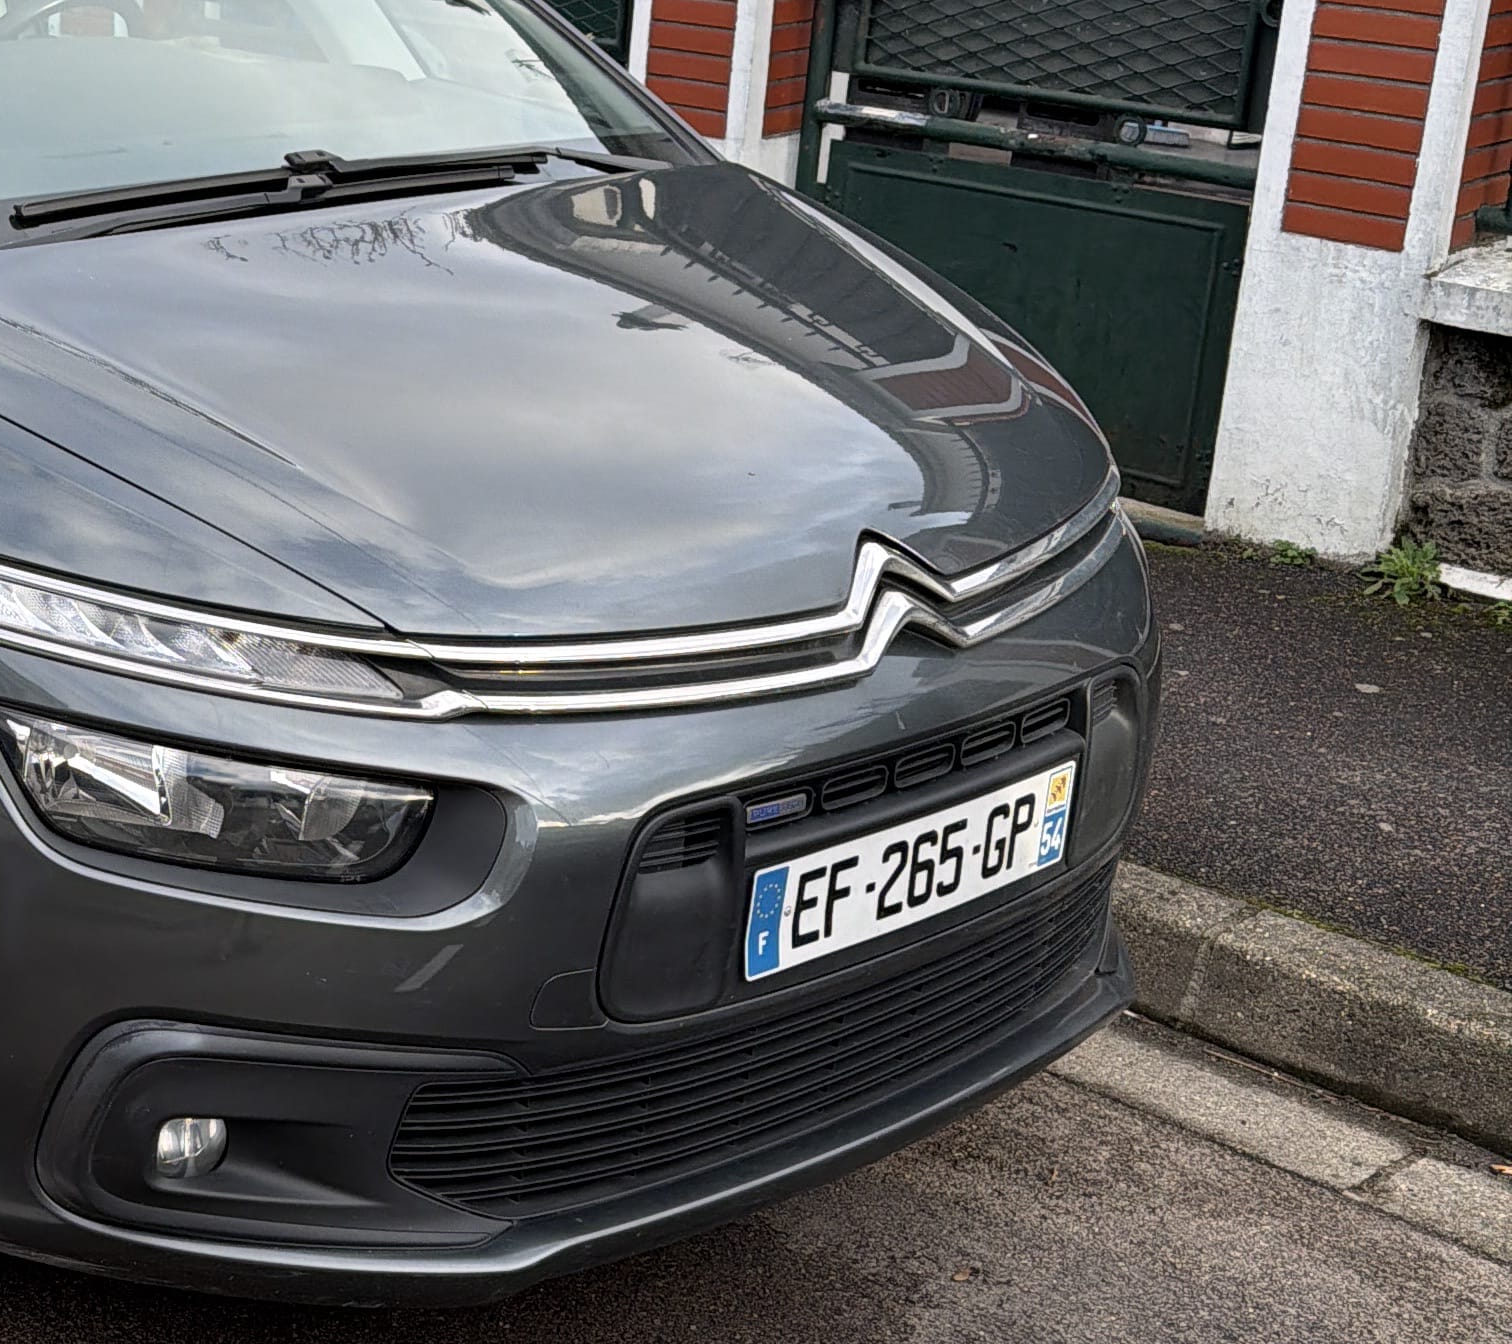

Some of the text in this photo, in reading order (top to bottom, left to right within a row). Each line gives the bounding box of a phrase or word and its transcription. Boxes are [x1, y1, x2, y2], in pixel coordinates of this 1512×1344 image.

[1040, 817, 1063, 856] 54
[792, 793, 1036, 949] EF-265-GP
[758, 931, 769, 955] F
